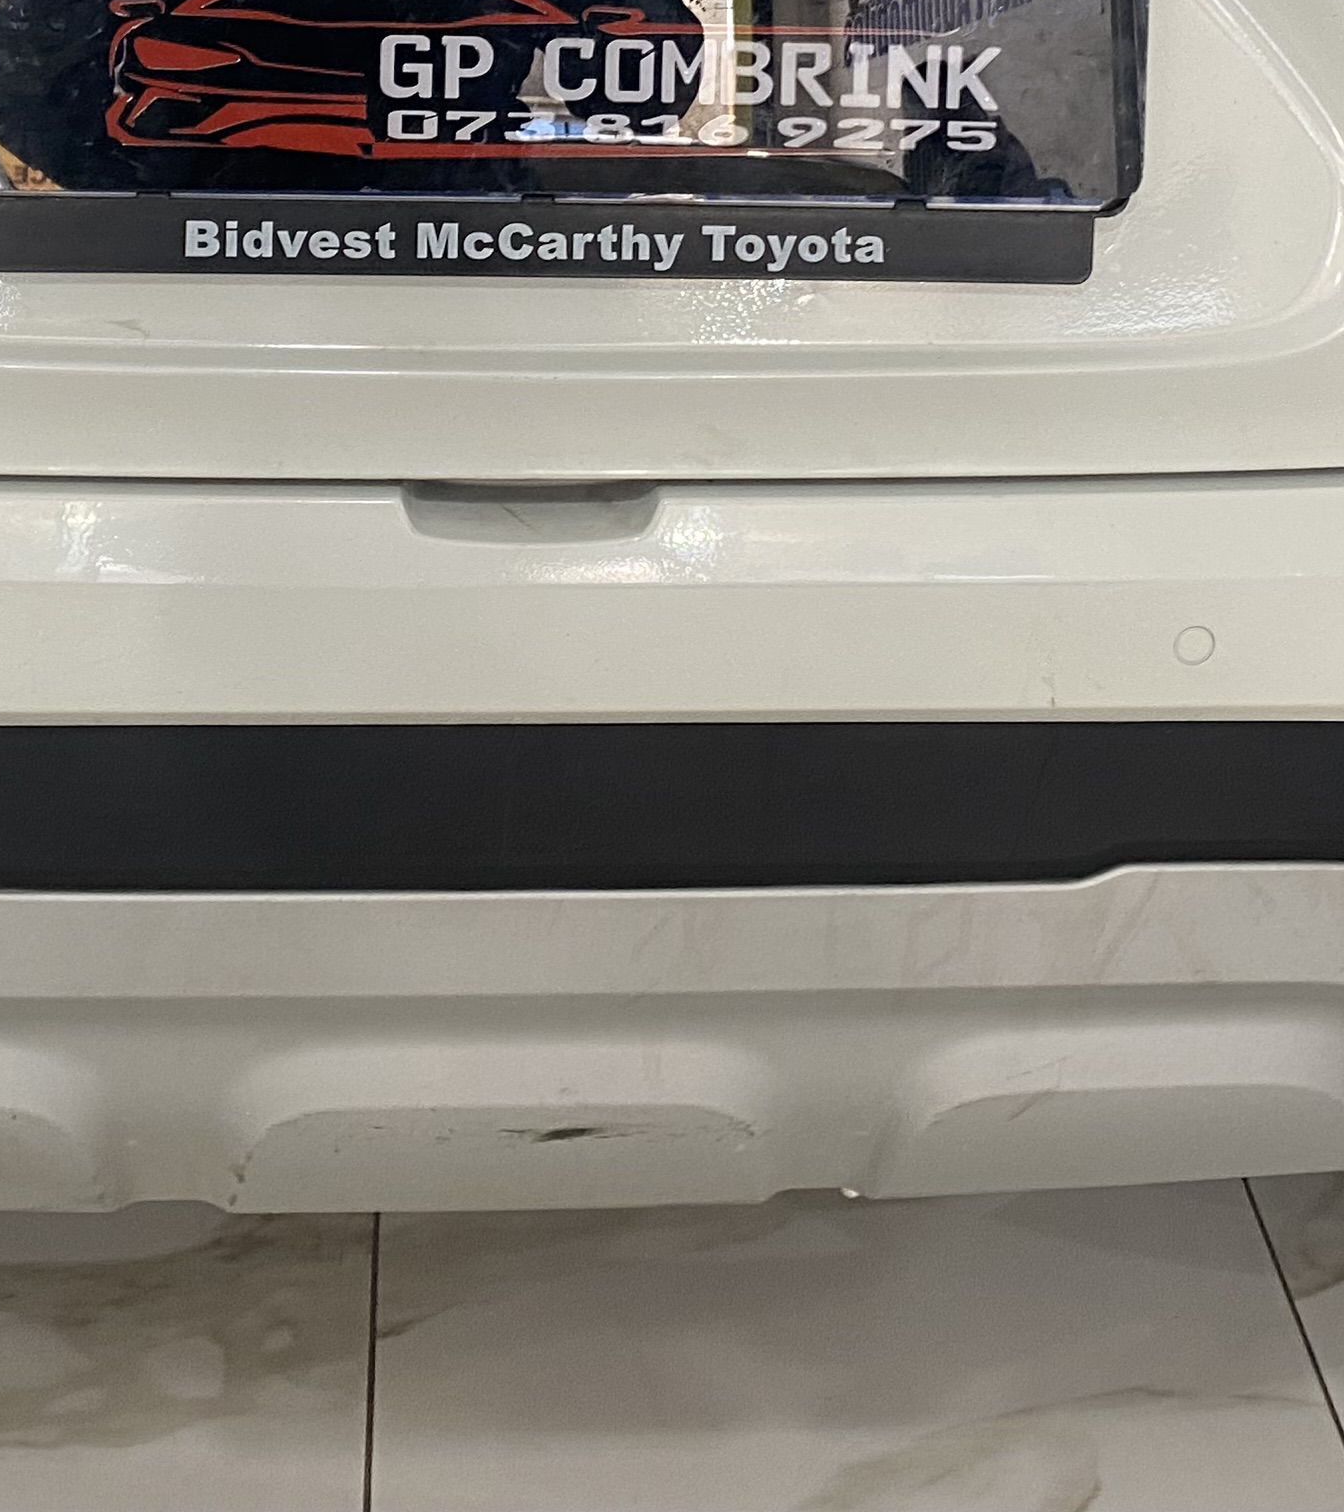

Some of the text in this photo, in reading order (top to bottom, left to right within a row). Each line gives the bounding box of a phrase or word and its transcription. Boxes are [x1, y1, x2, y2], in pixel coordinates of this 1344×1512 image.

[379, 34, 1002, 112] GP COMBRINK
[387, 109, 999, 152] 073 816 9275
[184, 220, 886, 272] Bidvest McCarthy Toyota
